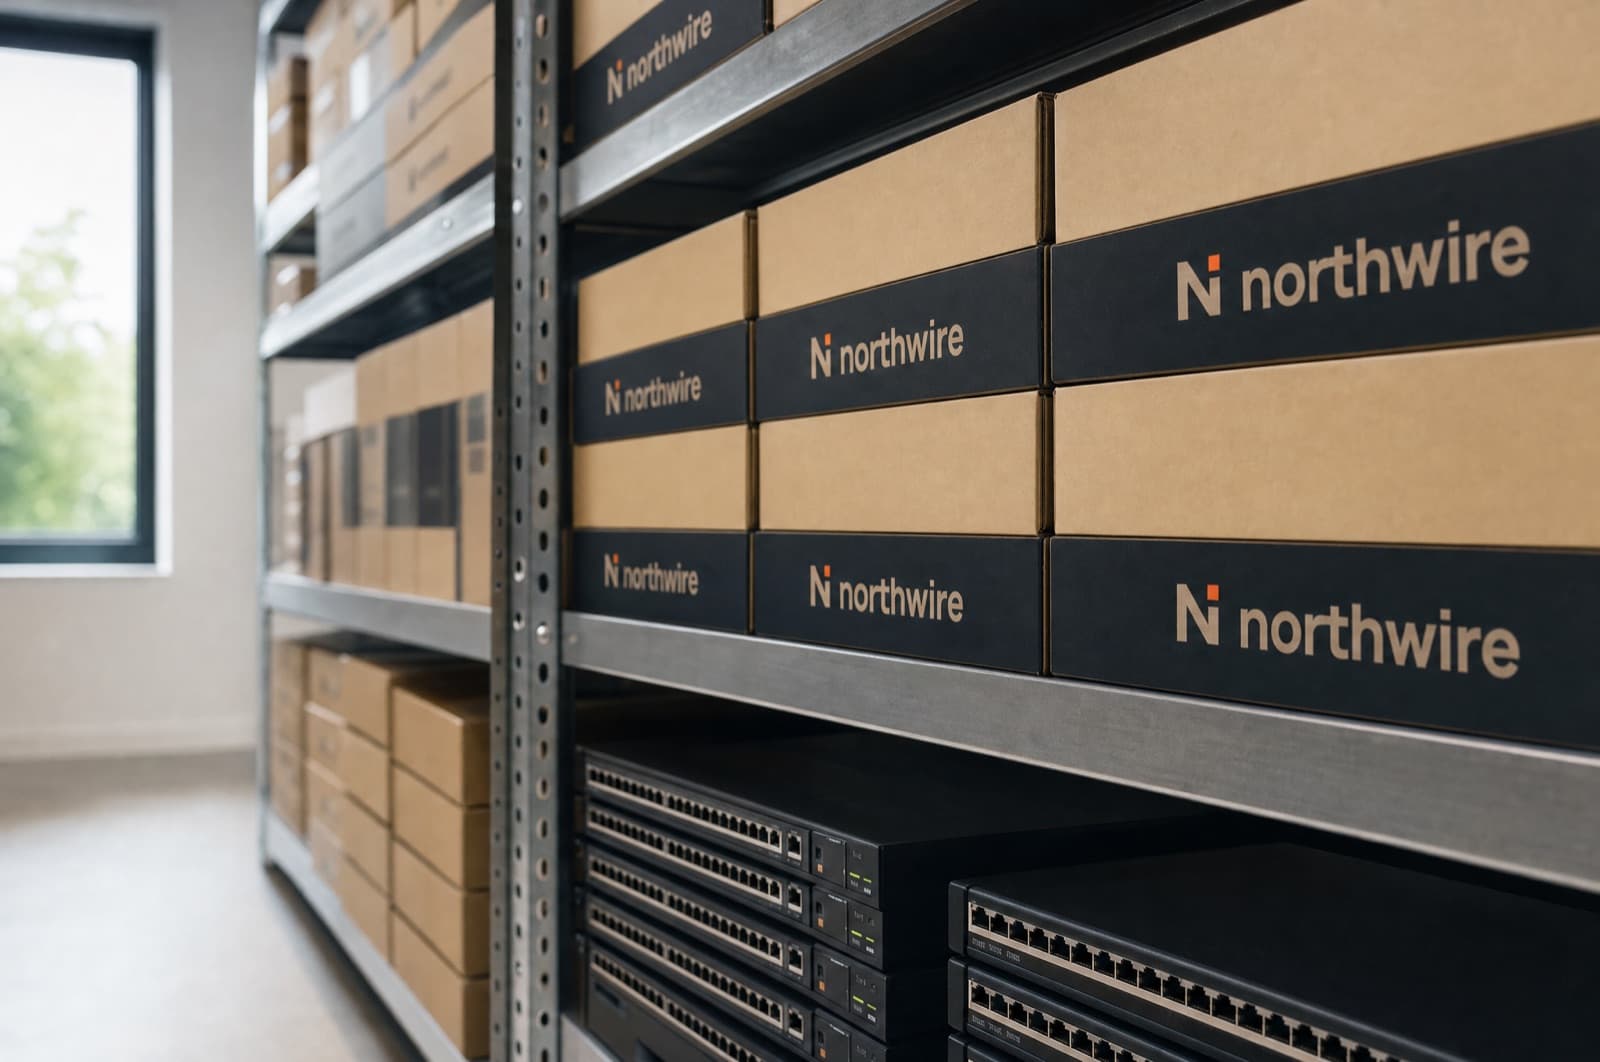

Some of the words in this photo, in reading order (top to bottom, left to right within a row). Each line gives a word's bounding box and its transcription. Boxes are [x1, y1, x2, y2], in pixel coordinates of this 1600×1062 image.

[627, 9, 713, 92] northwire
[1241, 219, 1531, 312] northwire
[839, 319, 965, 376] northwire
[624, 371, 702, 412] northwire
[623, 562, 699, 596] northwire
[839, 576, 964, 623] northwire
[1240, 603, 1521, 679] northwire
